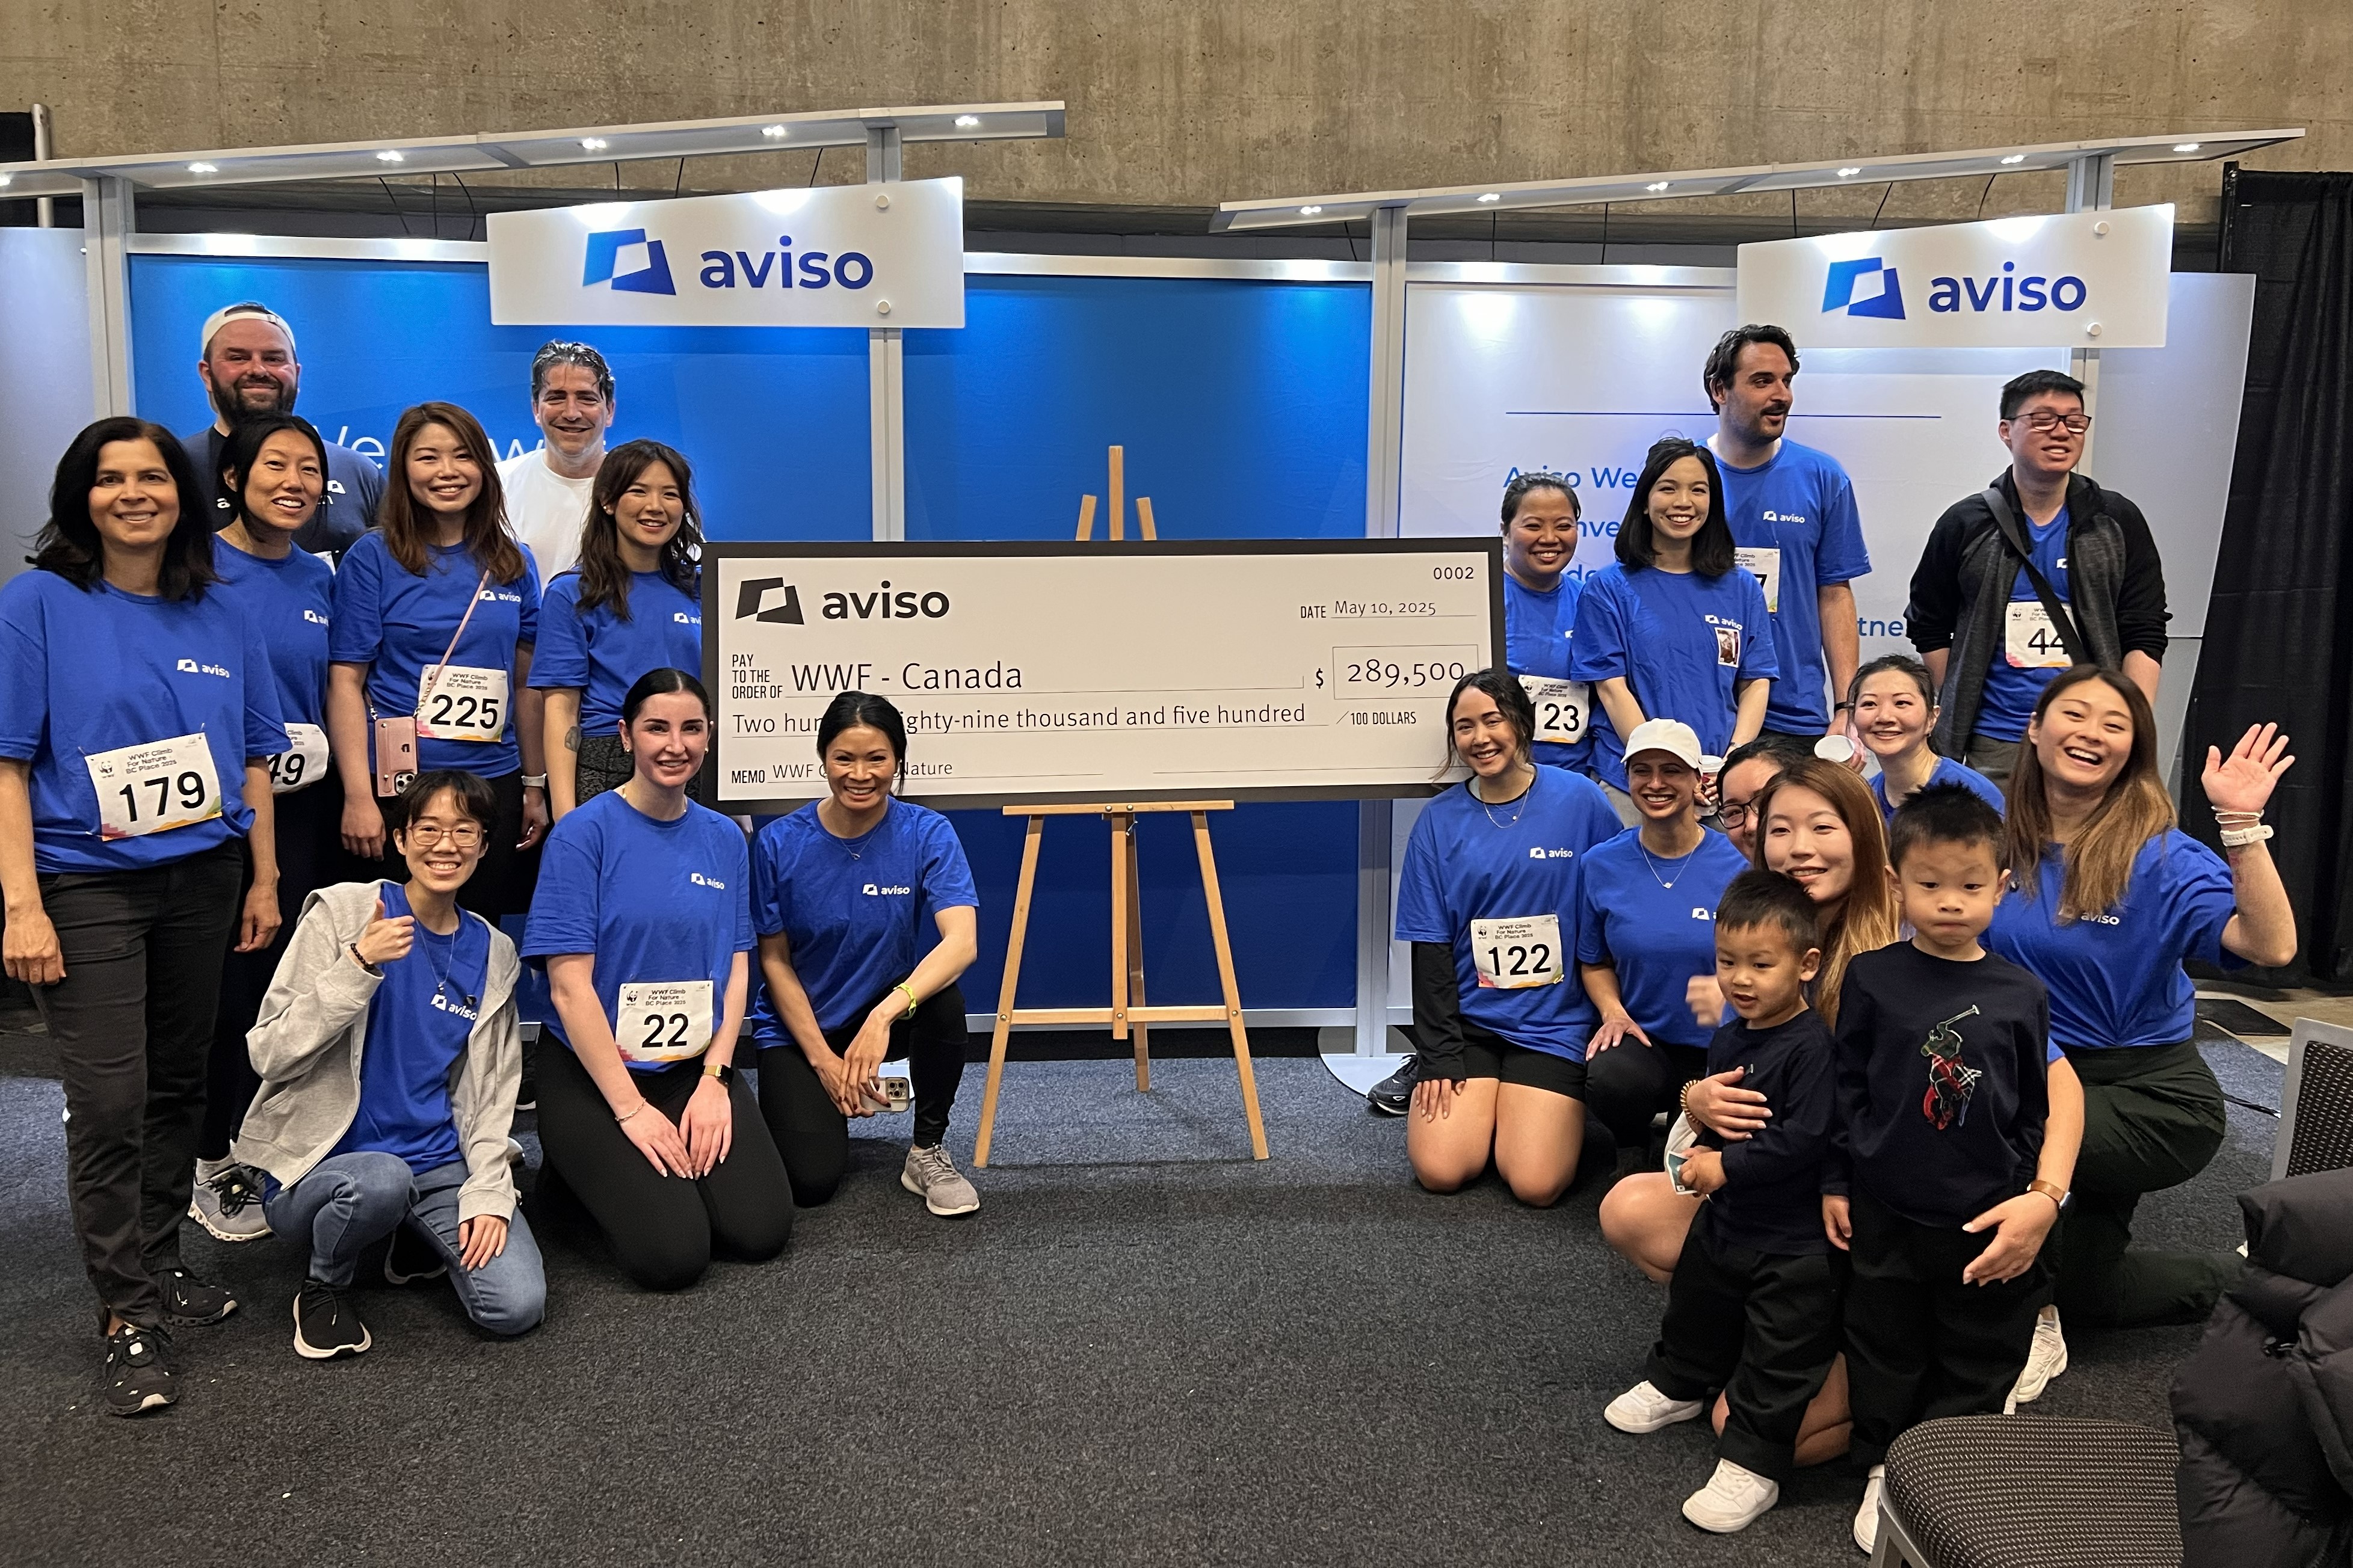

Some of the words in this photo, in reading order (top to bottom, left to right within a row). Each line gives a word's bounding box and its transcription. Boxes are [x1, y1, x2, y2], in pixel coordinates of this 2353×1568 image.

[700, 235, 873, 289] aviso
[1929, 261, 2086, 312] aviso
[1780, 514, 1805, 523] aviso
[1433, 567, 1474, 580] 0002
[498, 592, 522, 602] aviso
[822, 580, 949, 619] aviso
[1300, 606, 1327, 618] DATE
[1334, 600, 1366, 617] May
[1371, 603, 1393, 615] 10,
[1398, 602, 1436, 615] 2025
[732, 654, 754, 667] PAY
[732, 670, 746, 683] TO
[749, 669, 770, 683] THE
[791, 663, 872, 691] WWF
[902, 660, 1022, 690] Canada
[1315, 668, 1324, 689] $
[1348, 659, 1464, 687] 289,500
[732, 686, 767, 699] ORDER
[769, 685, 783, 698] OF
[430, 694, 499, 729] 225
[733, 714, 775, 733] Two
[900, 710, 1009, 734] ghty-nine
[1017, 707, 1118, 728] thousand
[1126, 706, 1165, 725] and
[1173, 706, 1209, 724] five
[1218, 703, 1305, 724] hundred
[1372, 711, 1416, 724] DOLLARS
[128, 751, 150, 761] WWF
[152, 748, 173, 756] Climb
[141, 755, 167, 765] Nature
[139, 763, 160, 772] Place
[732, 770, 765, 784] MEMO
[773, 764, 814, 778] WWF
[119, 771, 205, 822] 179
[1549, 847, 1573, 858] aviso
[881, 885, 910, 895] aviso
[2081, 912, 2120, 925] aviso
[1488, 944, 1551, 976] 122
[448, 1003, 477, 1021] aviso
[641, 1013, 688, 1048] 22
